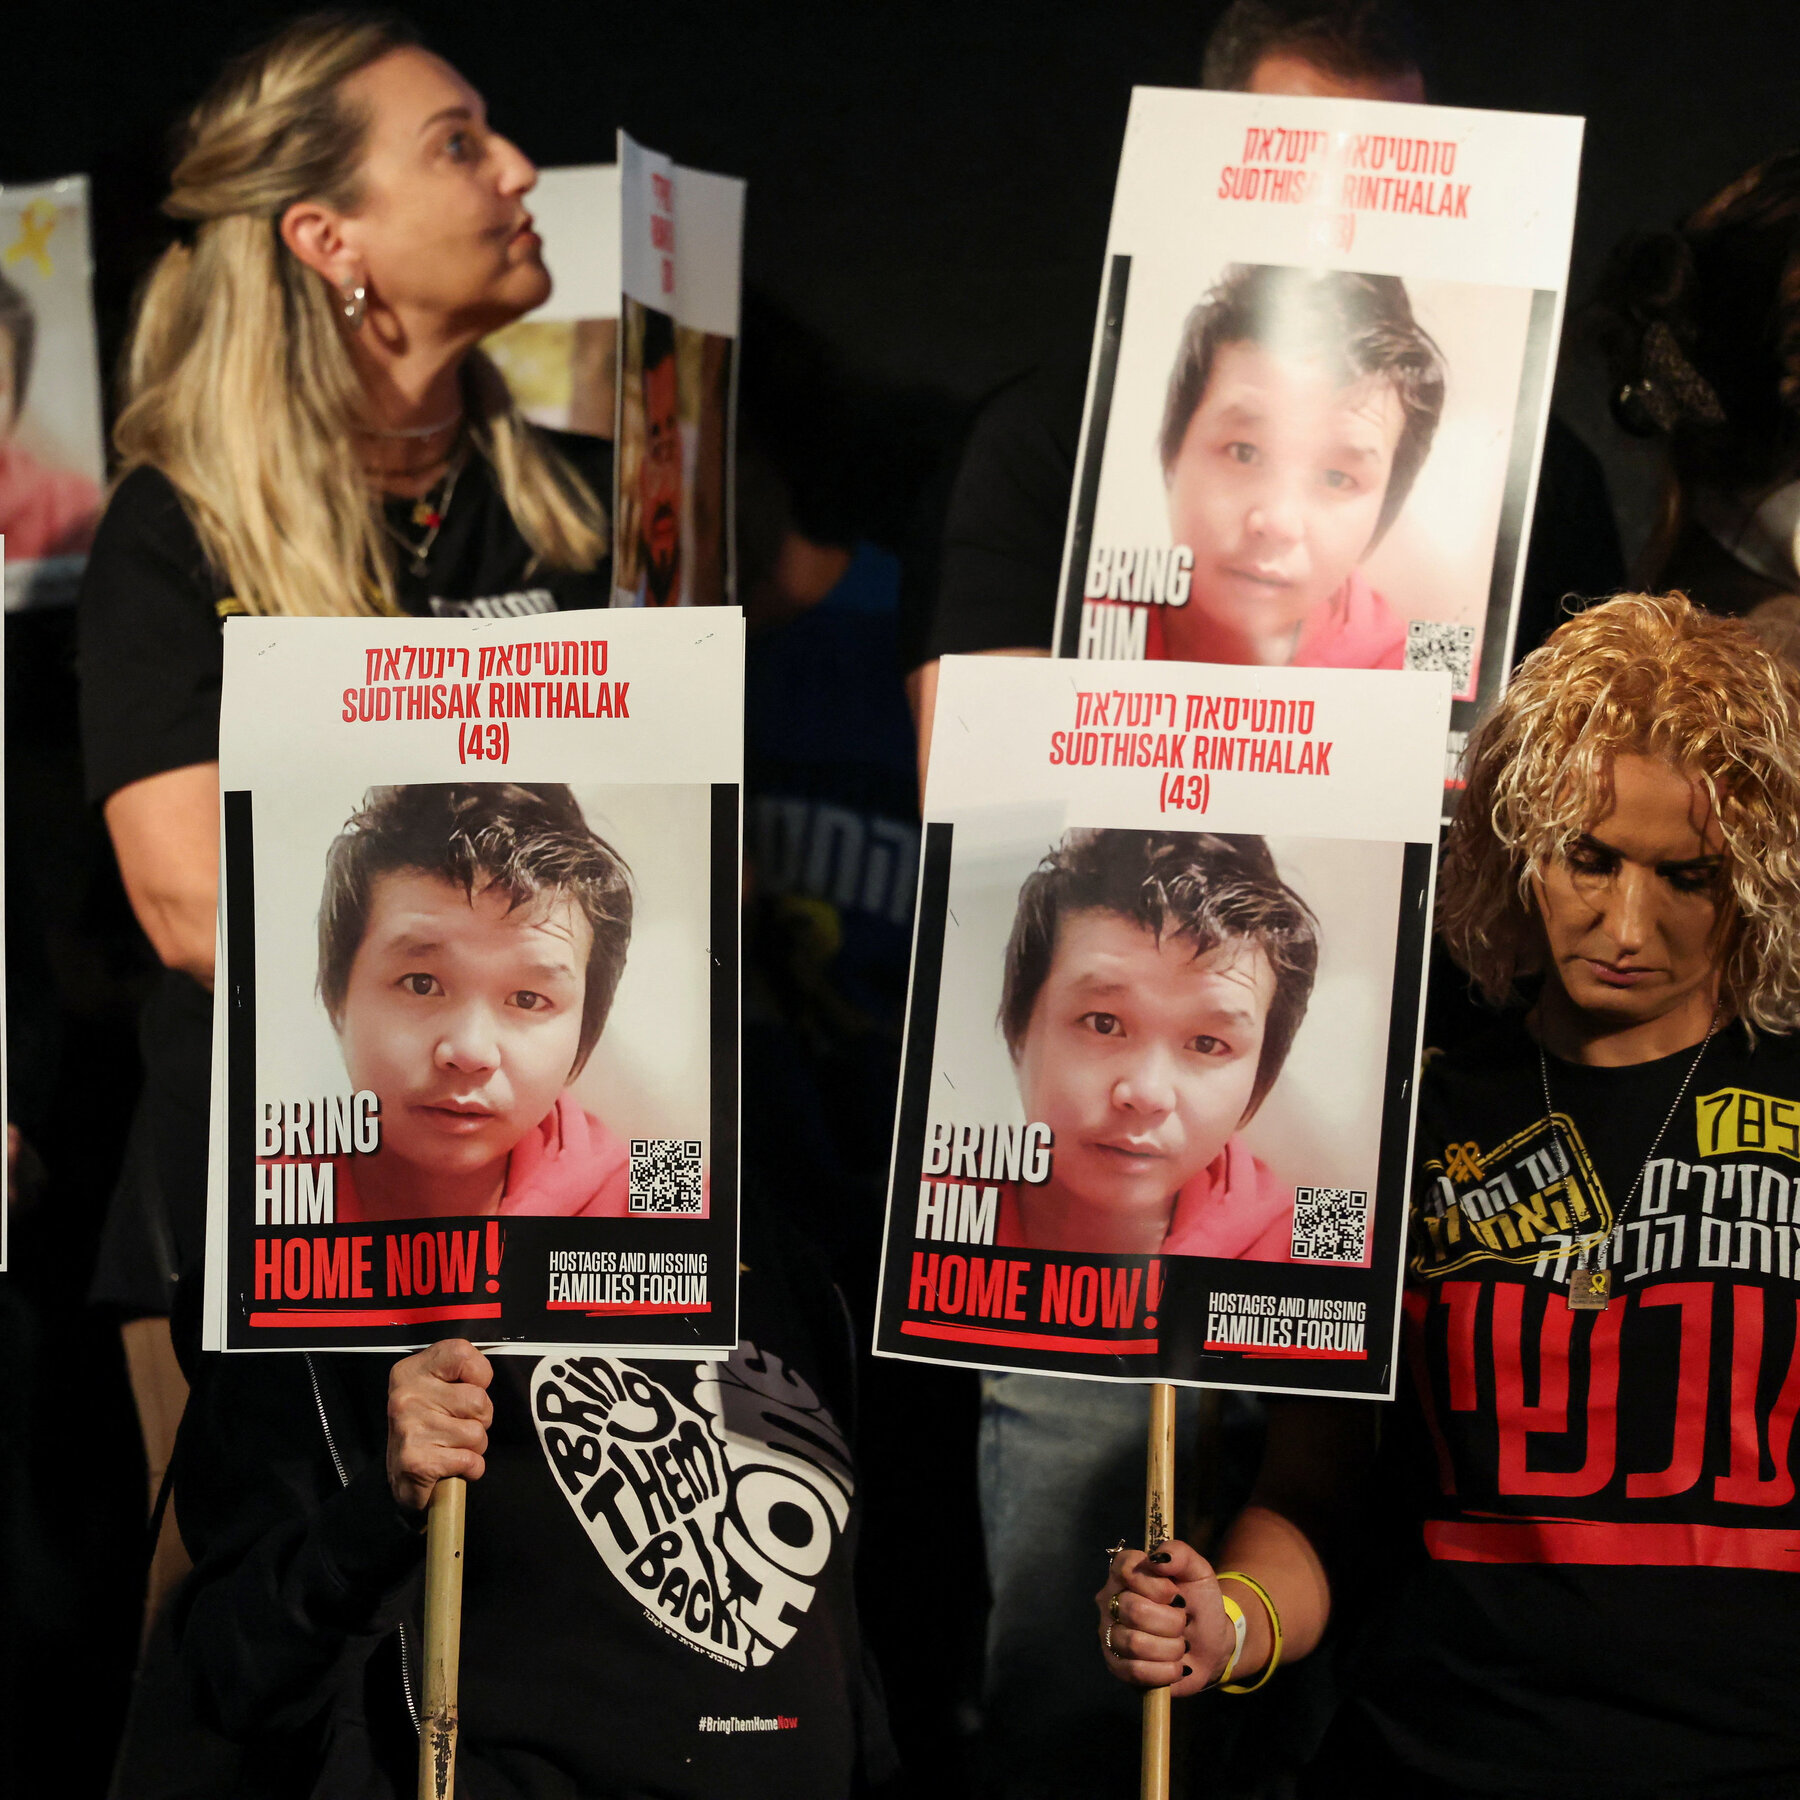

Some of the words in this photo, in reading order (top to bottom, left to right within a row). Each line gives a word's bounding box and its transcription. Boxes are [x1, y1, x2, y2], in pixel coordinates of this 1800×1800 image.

[1343, 133, 1458, 176] סותטיסא
[1218, 165, 1318, 206] SUDTHIS
[1085, 544, 1194, 607] BRING
[1079, 602, 1149, 660] HIM
[365, 646, 469, 687] רינטלאק
[479, 640, 609, 682] סותטיסאק
[342, 683, 482, 722] SUDTHISAK
[489, 681, 630, 719] RINTHALAK
[1075, 688, 1176, 730] רינטלאק
[1185, 693, 1315, 735] סותטיסאק
[458, 721, 510, 765] (43)
[1049, 730, 1185, 769] SUDTHISAK
[1193, 735, 1333, 776] RINTHALAK
[1160, 771, 1211, 815] (43)
[255, 1089, 380, 1157] BRING
[1703, 1093, 1800, 1158] 785
[921, 1121, 1052, 1184] BRING
[255, 1162, 334, 1226] HIM
[1639, 1157, 1800, 1223] חזירים
[914, 1181, 999, 1246] HIM
[254, 1235, 374, 1301] HOME
[386, 1220, 506, 1298] NOW!
[549, 1250, 617, 1273] HOSTAGES
[619, 1252, 646, 1274] AND
[648, 1253, 708, 1274] MISSING
[1698, 1214, 1800, 1281] ותם
[548, 1272, 634, 1304] FAMILIES
[639, 1274, 708, 1306] FORUM
[907, 1251, 1032, 1321] HOME
[1039, 1259, 1166, 1330] NOW!
[1208, 1291, 1277, 1317] HOSTAGES
[1278, 1296, 1305, 1319] AND
[1307, 1298, 1367, 1323] MISSING
[1206, 1313, 1292, 1349] FAMILIES
[1296, 1319, 1365, 1353] FORUM
[698, 1715, 798, 1735] #BringThemHomeNow
